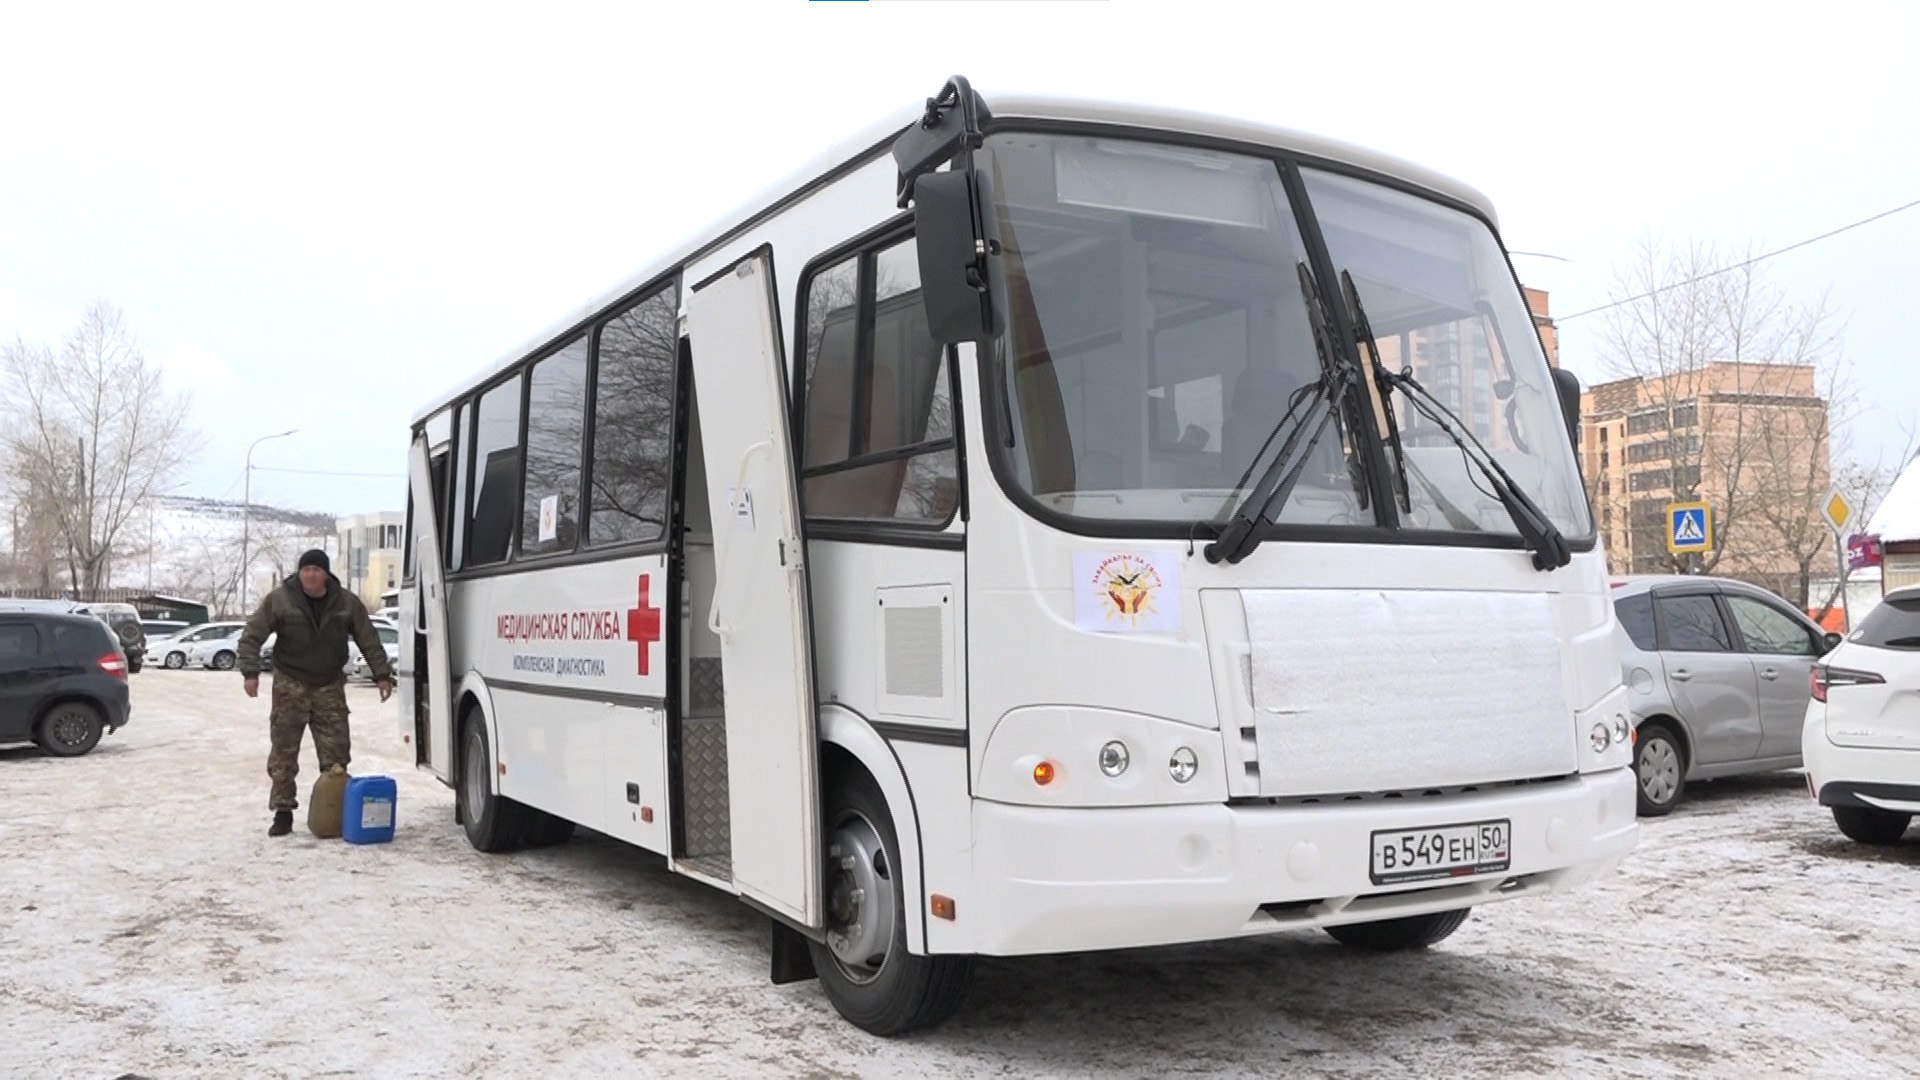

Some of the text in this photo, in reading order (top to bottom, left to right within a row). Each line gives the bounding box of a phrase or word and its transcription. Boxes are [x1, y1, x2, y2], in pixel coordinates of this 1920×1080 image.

[496, 611, 621, 643] МЕДИЦИНСКАЯ СЛУЖБА
[513, 655, 606, 677] КОМПЛЕКСНАЯ ДИАГНОСТИКА
[1481, 827, 1502, 849] 50
